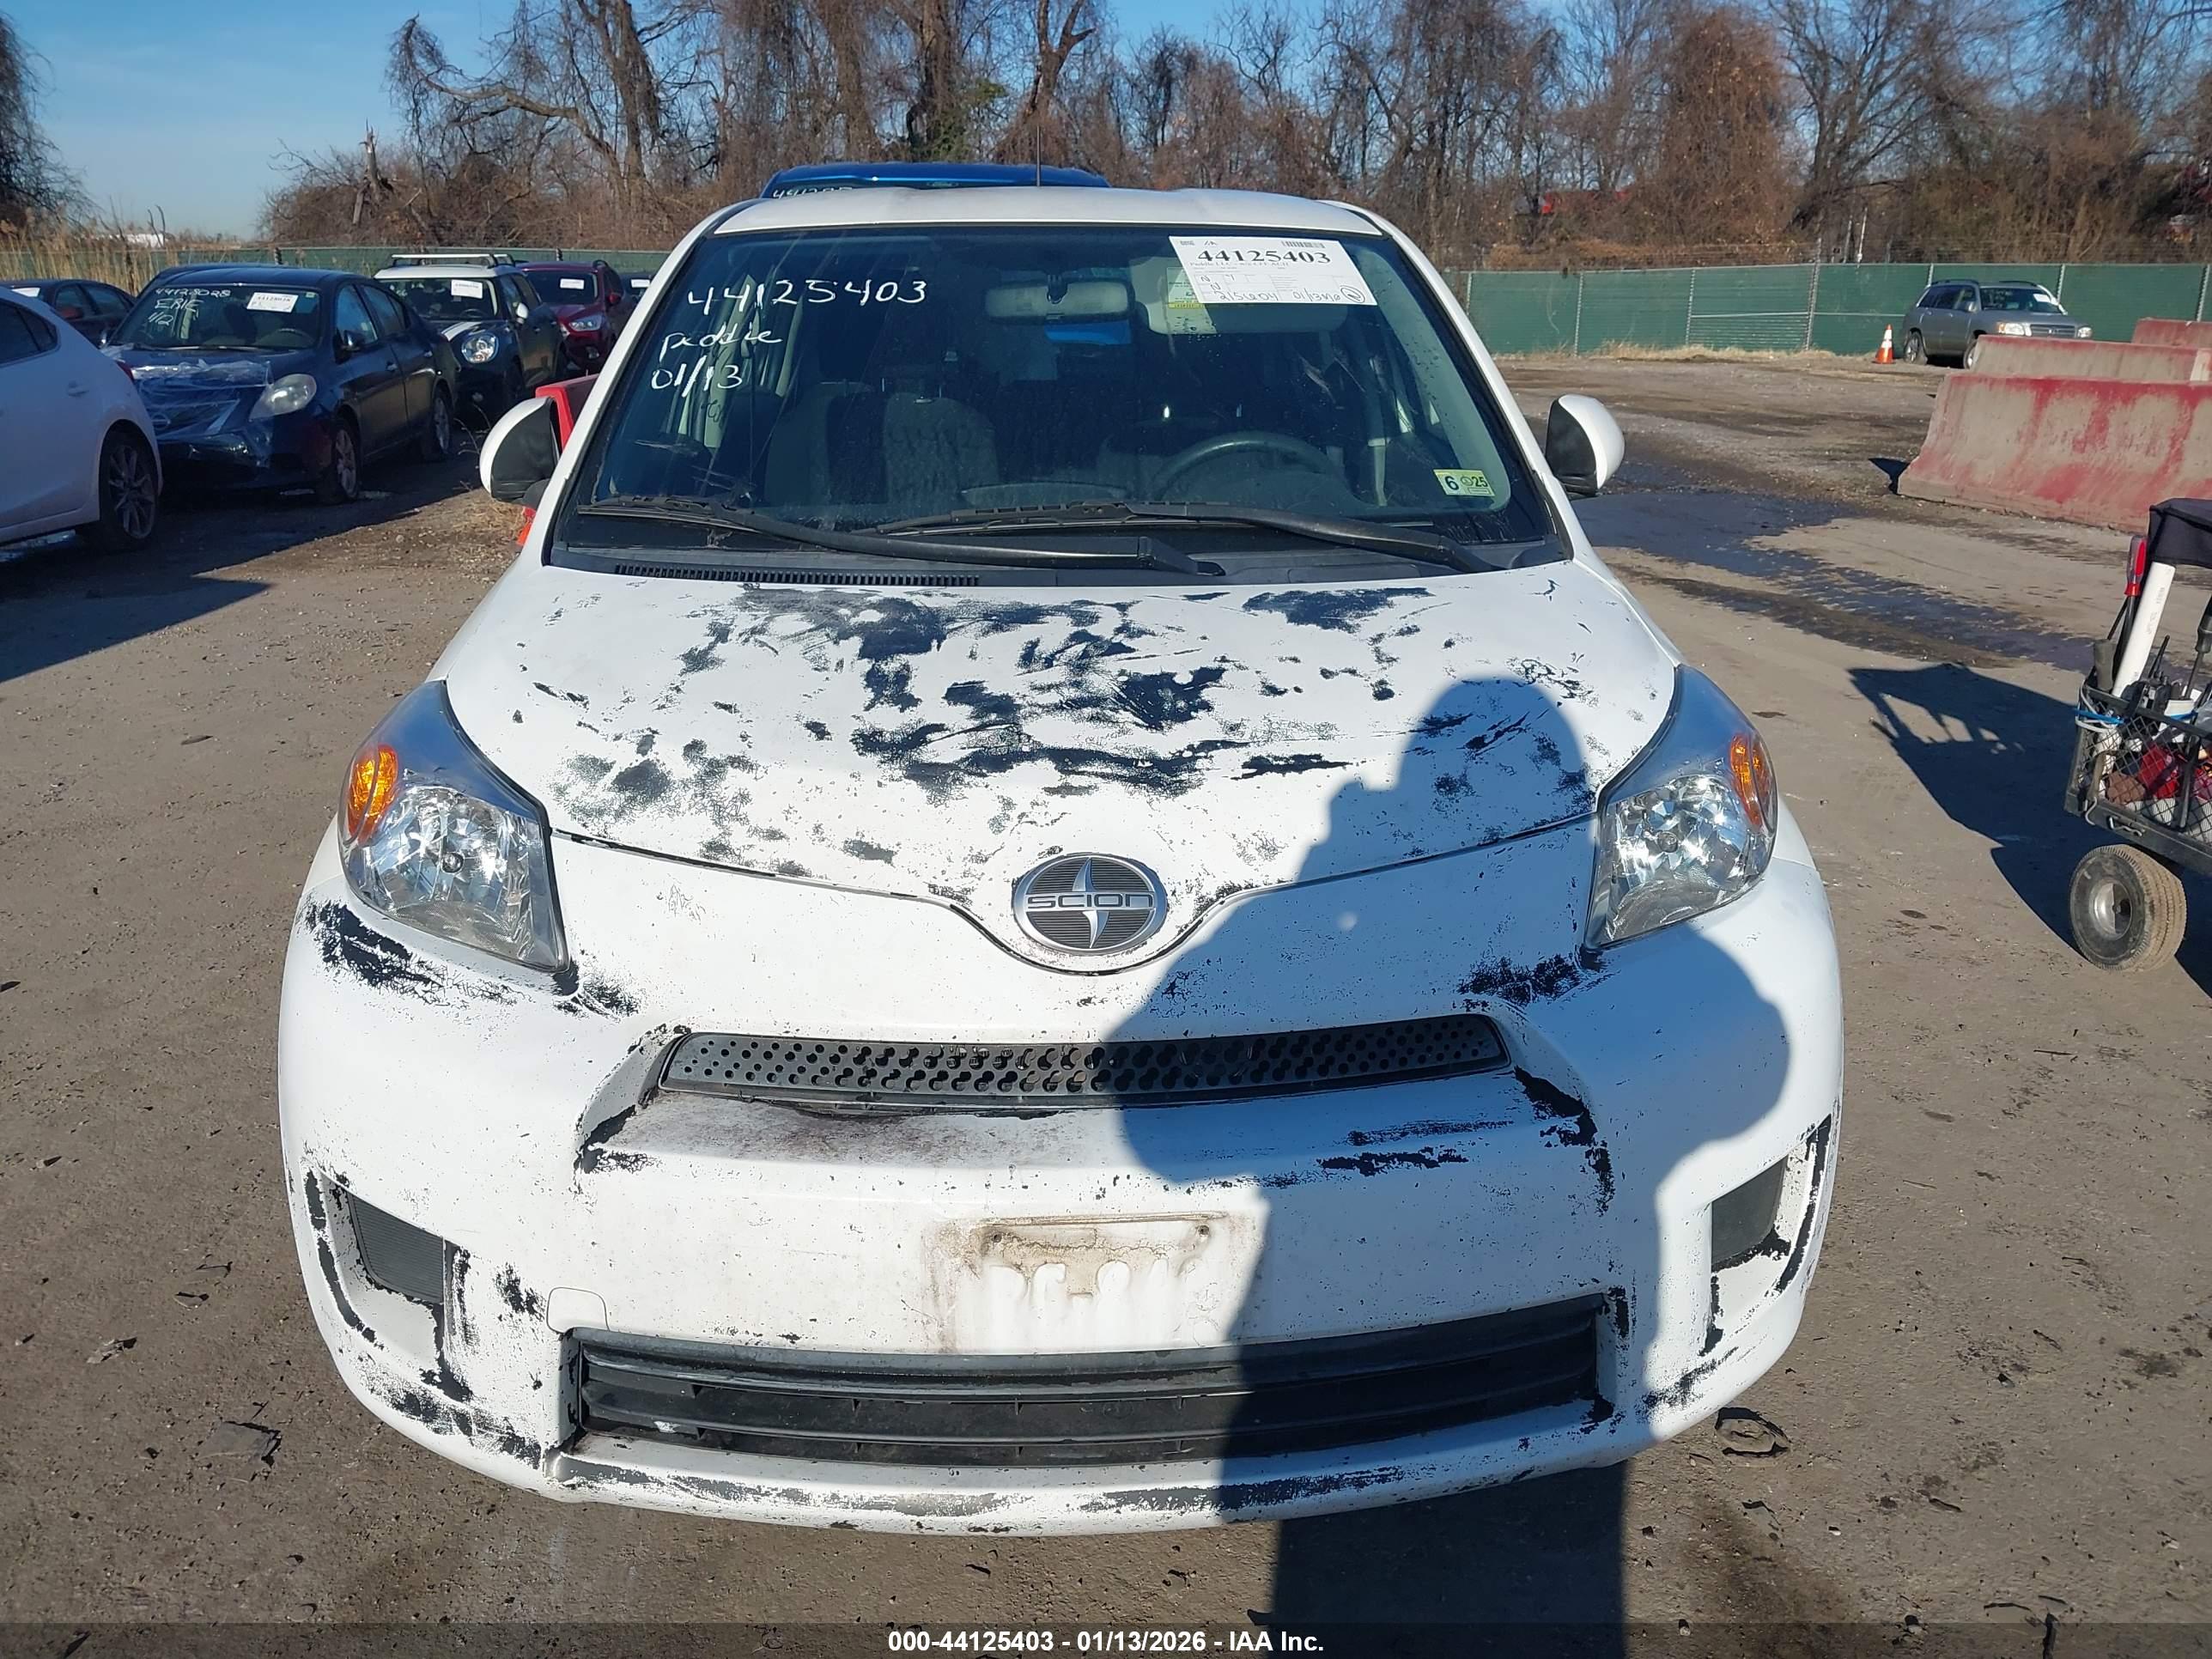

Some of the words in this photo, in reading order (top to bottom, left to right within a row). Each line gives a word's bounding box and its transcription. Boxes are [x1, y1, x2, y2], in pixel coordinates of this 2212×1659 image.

[1198, 250, 1331, 264] 44125403
[687, 279, 927, 315] 44125403
[651, 355, 743, 396] 01/13
[1445, 476, 1459, 490] 6
[1472, 477, 1488, 487] 25
[1027, 893, 1153, 908] SCION
